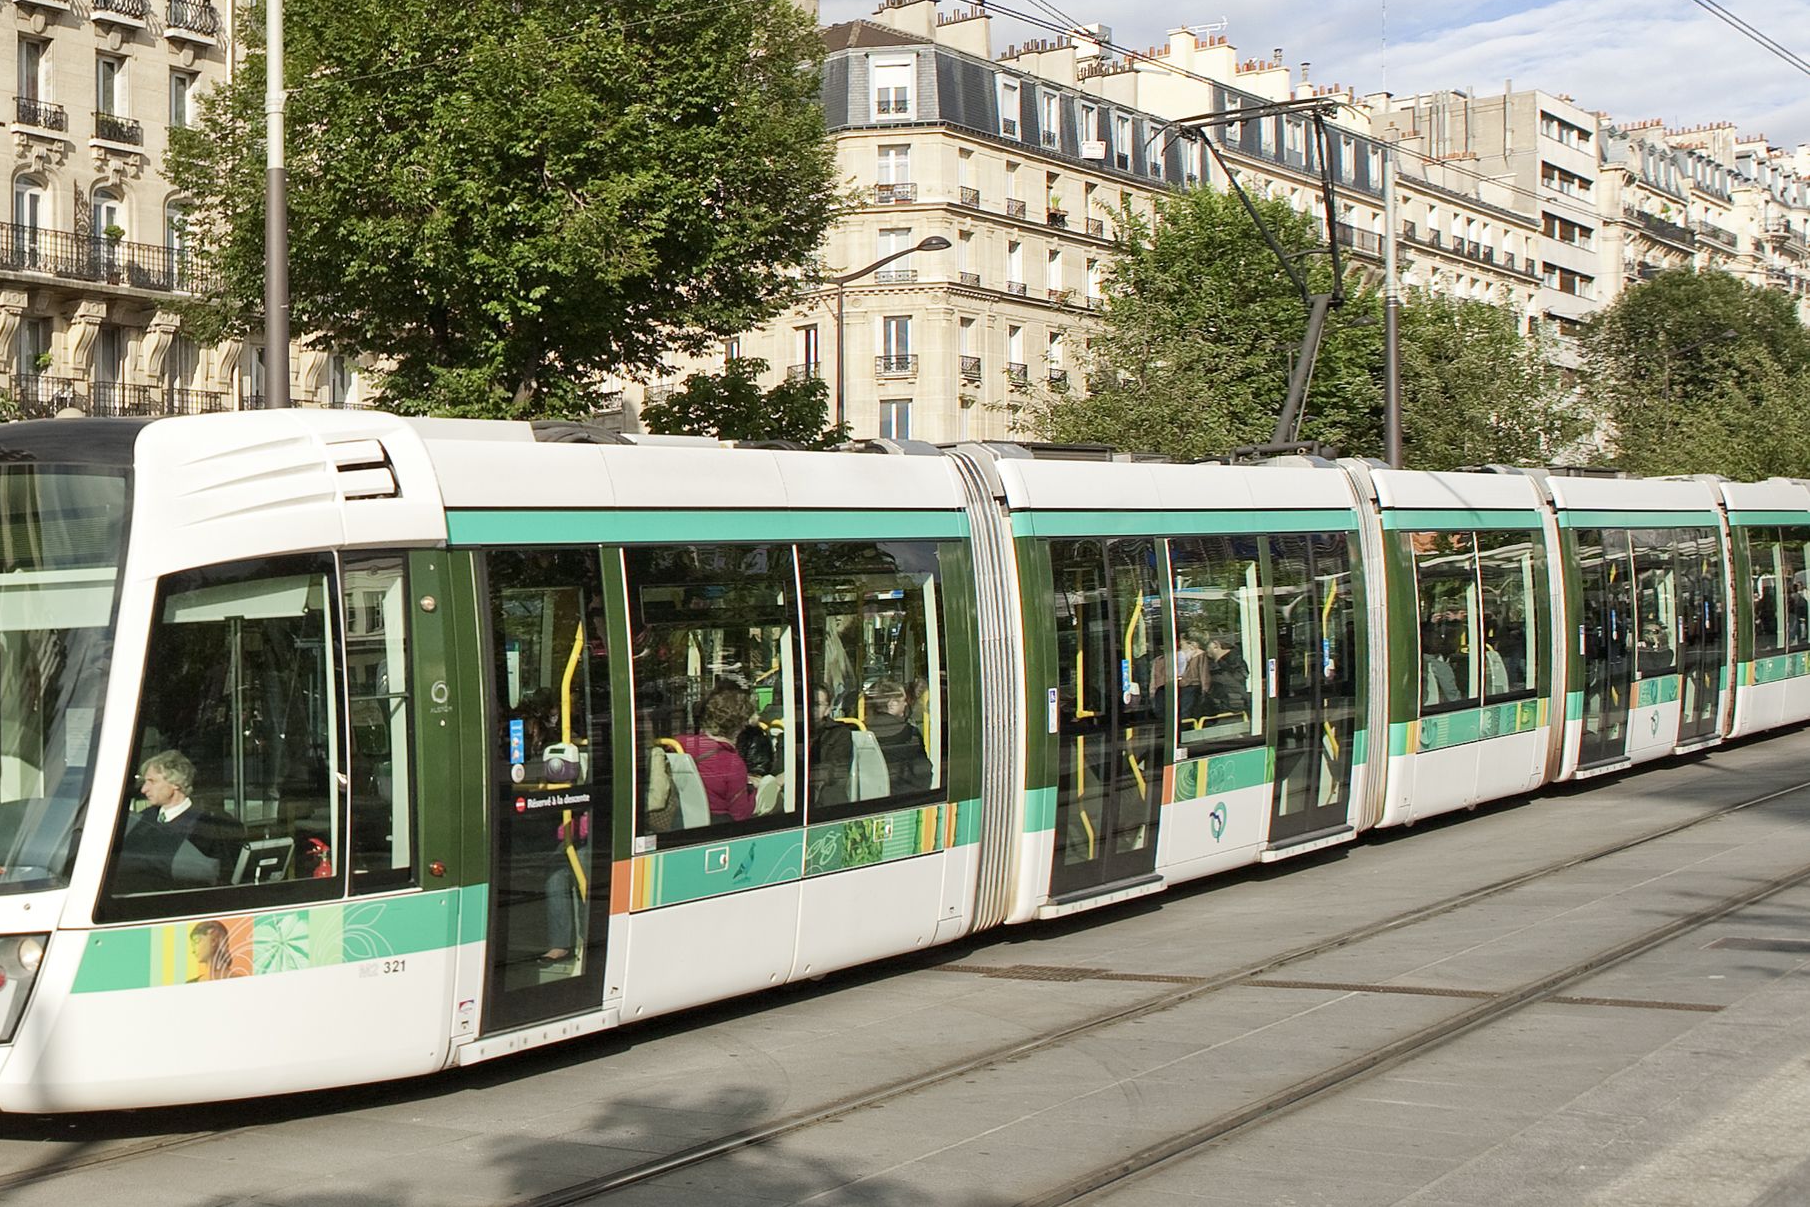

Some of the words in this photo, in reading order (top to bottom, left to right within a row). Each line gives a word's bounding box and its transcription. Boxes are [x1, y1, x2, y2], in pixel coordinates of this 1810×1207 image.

[527, 796, 551, 809] Réservé
[564, 794, 590, 804] descente
[383, 960, 406, 974] 321
